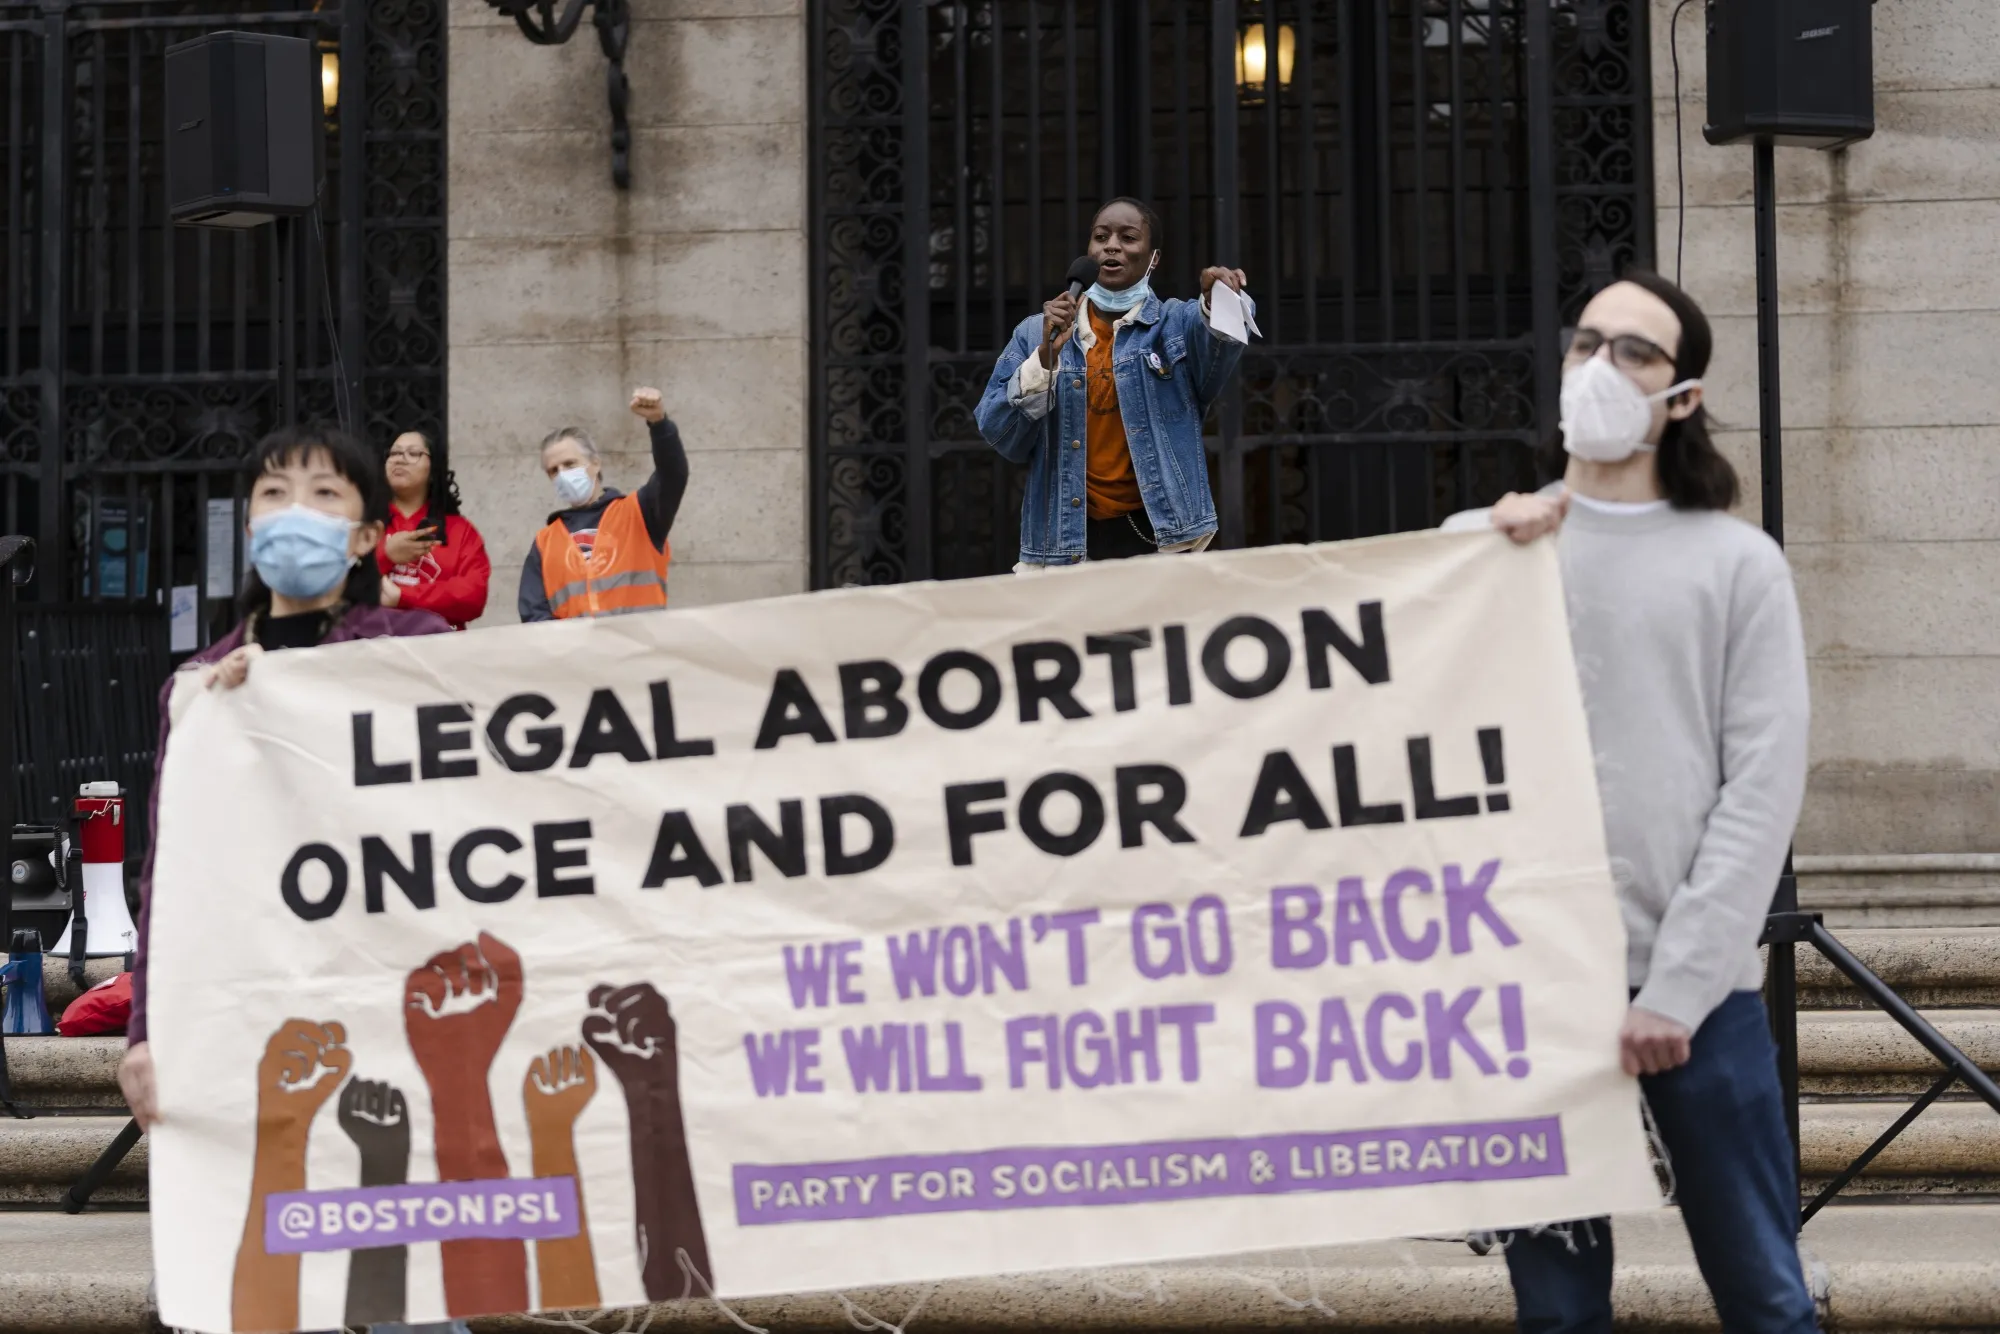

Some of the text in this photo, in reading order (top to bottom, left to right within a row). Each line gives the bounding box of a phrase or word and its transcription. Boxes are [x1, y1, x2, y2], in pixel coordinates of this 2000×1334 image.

[1797, 25, 1837, 39] BOSE
[353, 602, 1389, 786] LEGAL ABORTION
[281, 728, 1509, 921] ONCE AND FOR ALL!
[785, 859, 1519, 1007] WE WON'T GO BACK
[745, 985, 1529, 1095] WE WILL FIGHT BACK!
[751, 1134, 1547, 1209] PARTY FOR SOCIALISM & LIBERATION
